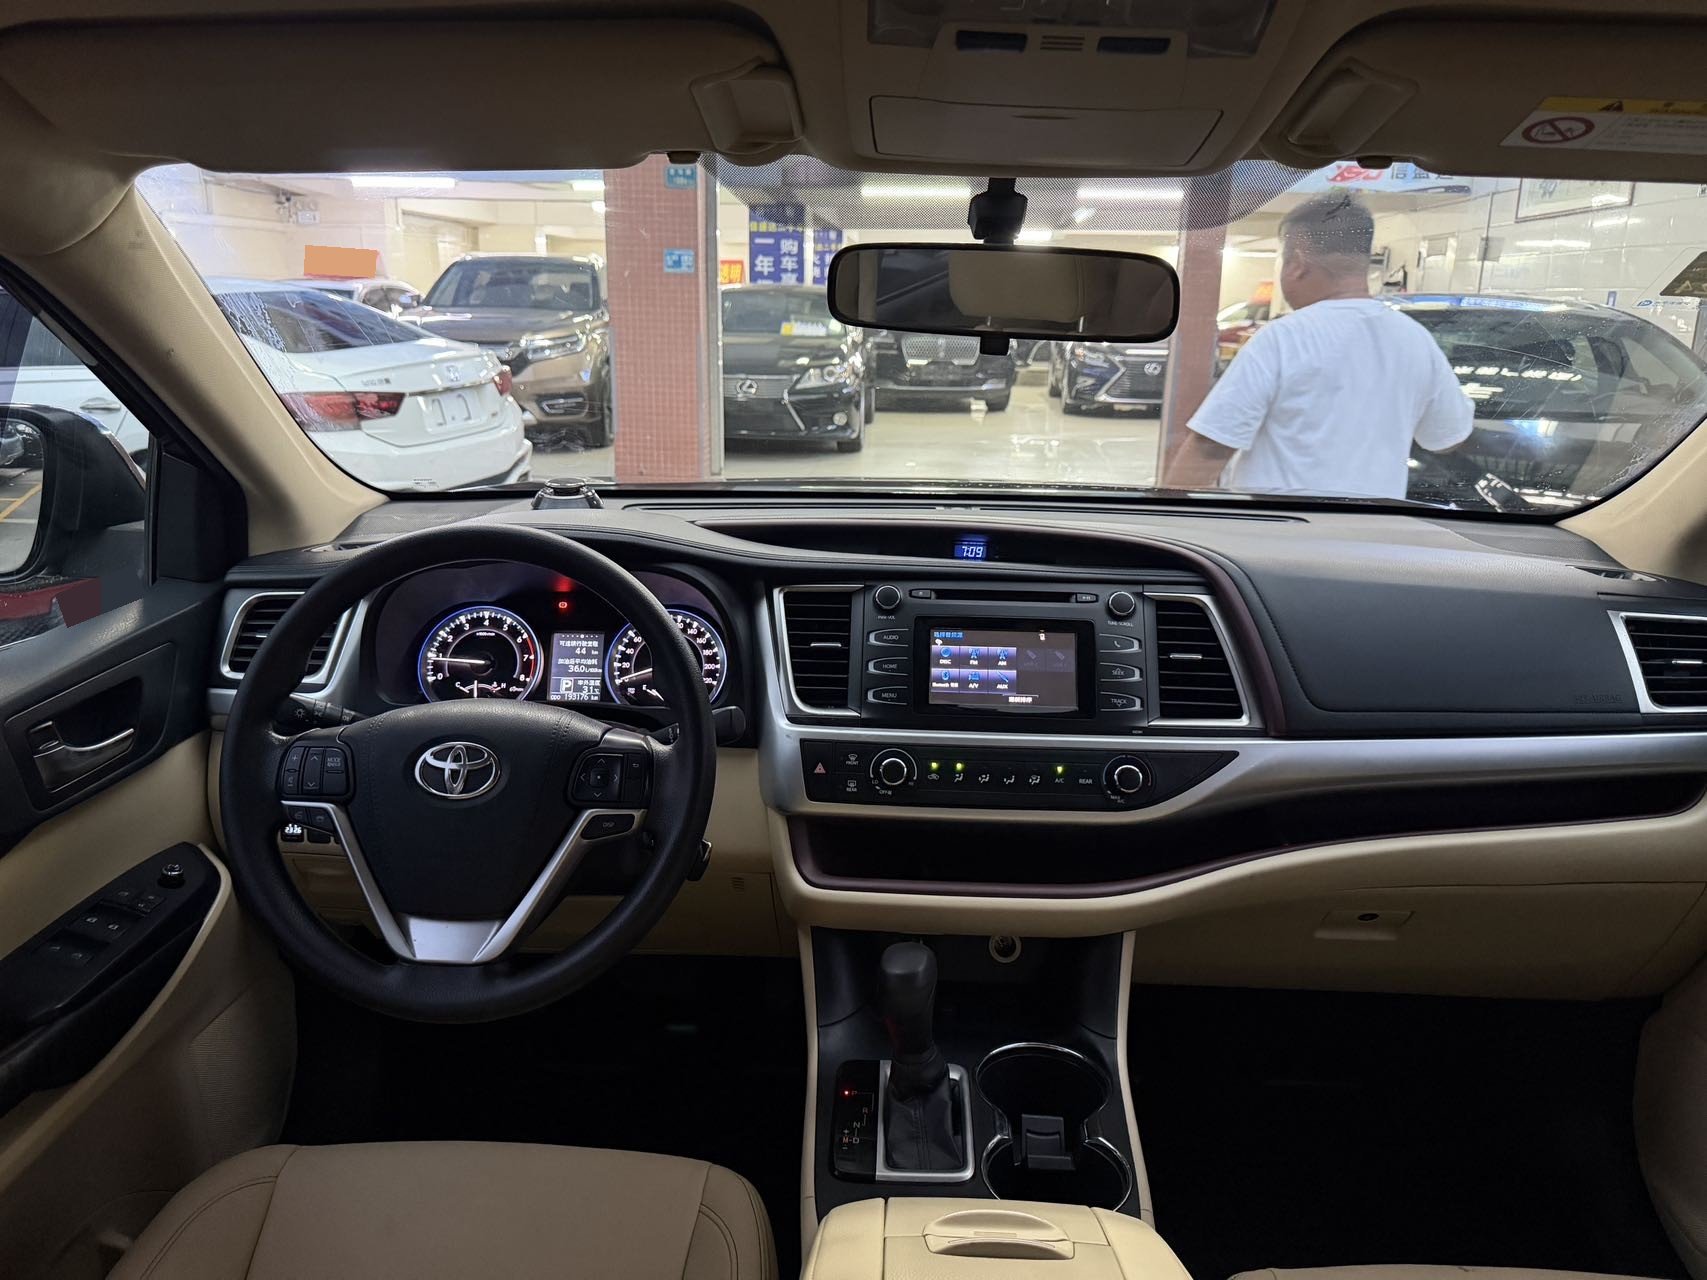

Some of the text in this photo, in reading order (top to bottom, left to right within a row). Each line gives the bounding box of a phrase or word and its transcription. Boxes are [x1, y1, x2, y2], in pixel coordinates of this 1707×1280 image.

[962, 546, 983, 558] 7:09
[575, 647, 586, 655] 44
[562, 680, 572, 692] P
